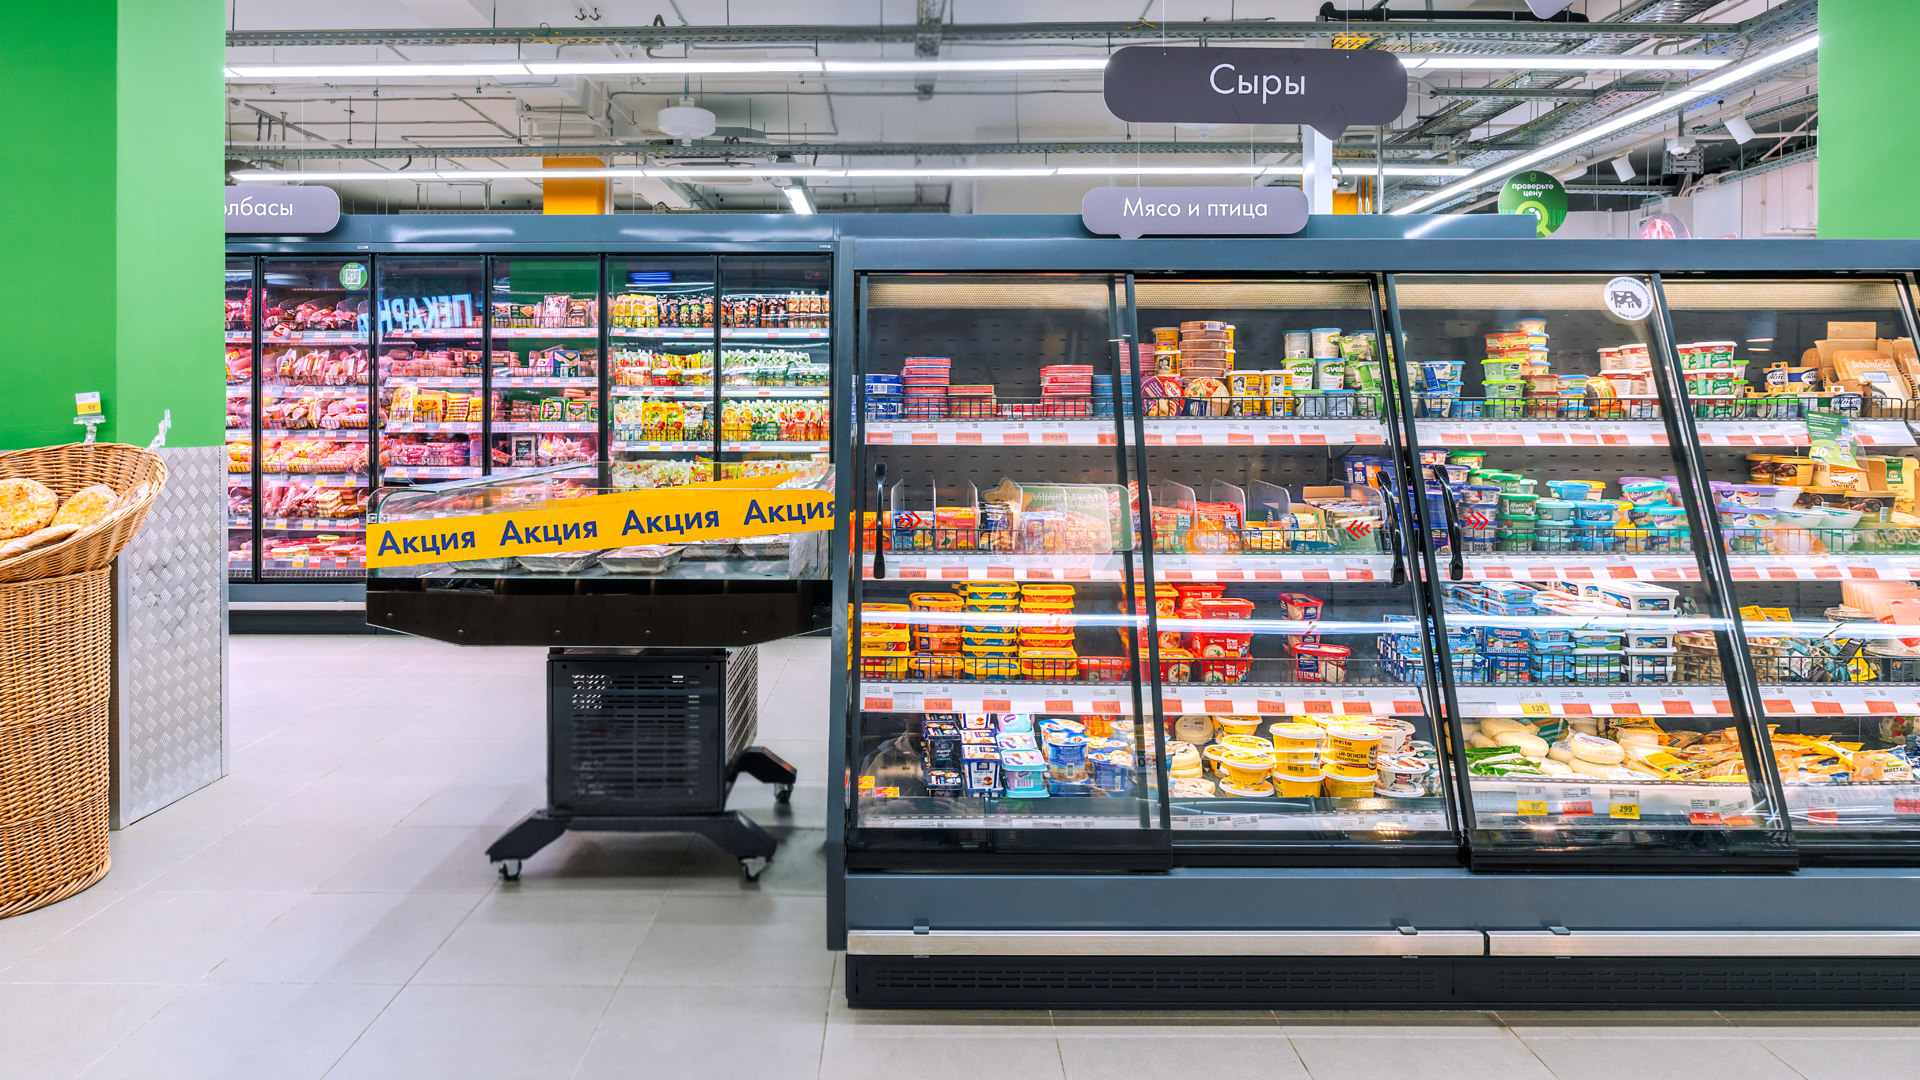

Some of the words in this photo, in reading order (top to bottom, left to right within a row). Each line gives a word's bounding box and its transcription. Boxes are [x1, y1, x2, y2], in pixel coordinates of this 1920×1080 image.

[1209, 63, 1305, 104] Сыры
[1511, 182, 1554, 191] проверьте
[1523, 190, 1543, 198] цену
[1123, 197, 1181, 217] Мясо
[1188, 202, 1200, 217] и
[1207, 202, 1268, 219] птица
[1851, 359, 1891, 370] Schönfeld
[378, 530, 476, 556] Акция
[499, 520, 598, 546] Акция
[621, 509, 720, 536] Акция
[1531, 802, 1540, 810] 99
[1619, 805, 1633, 813] 299
